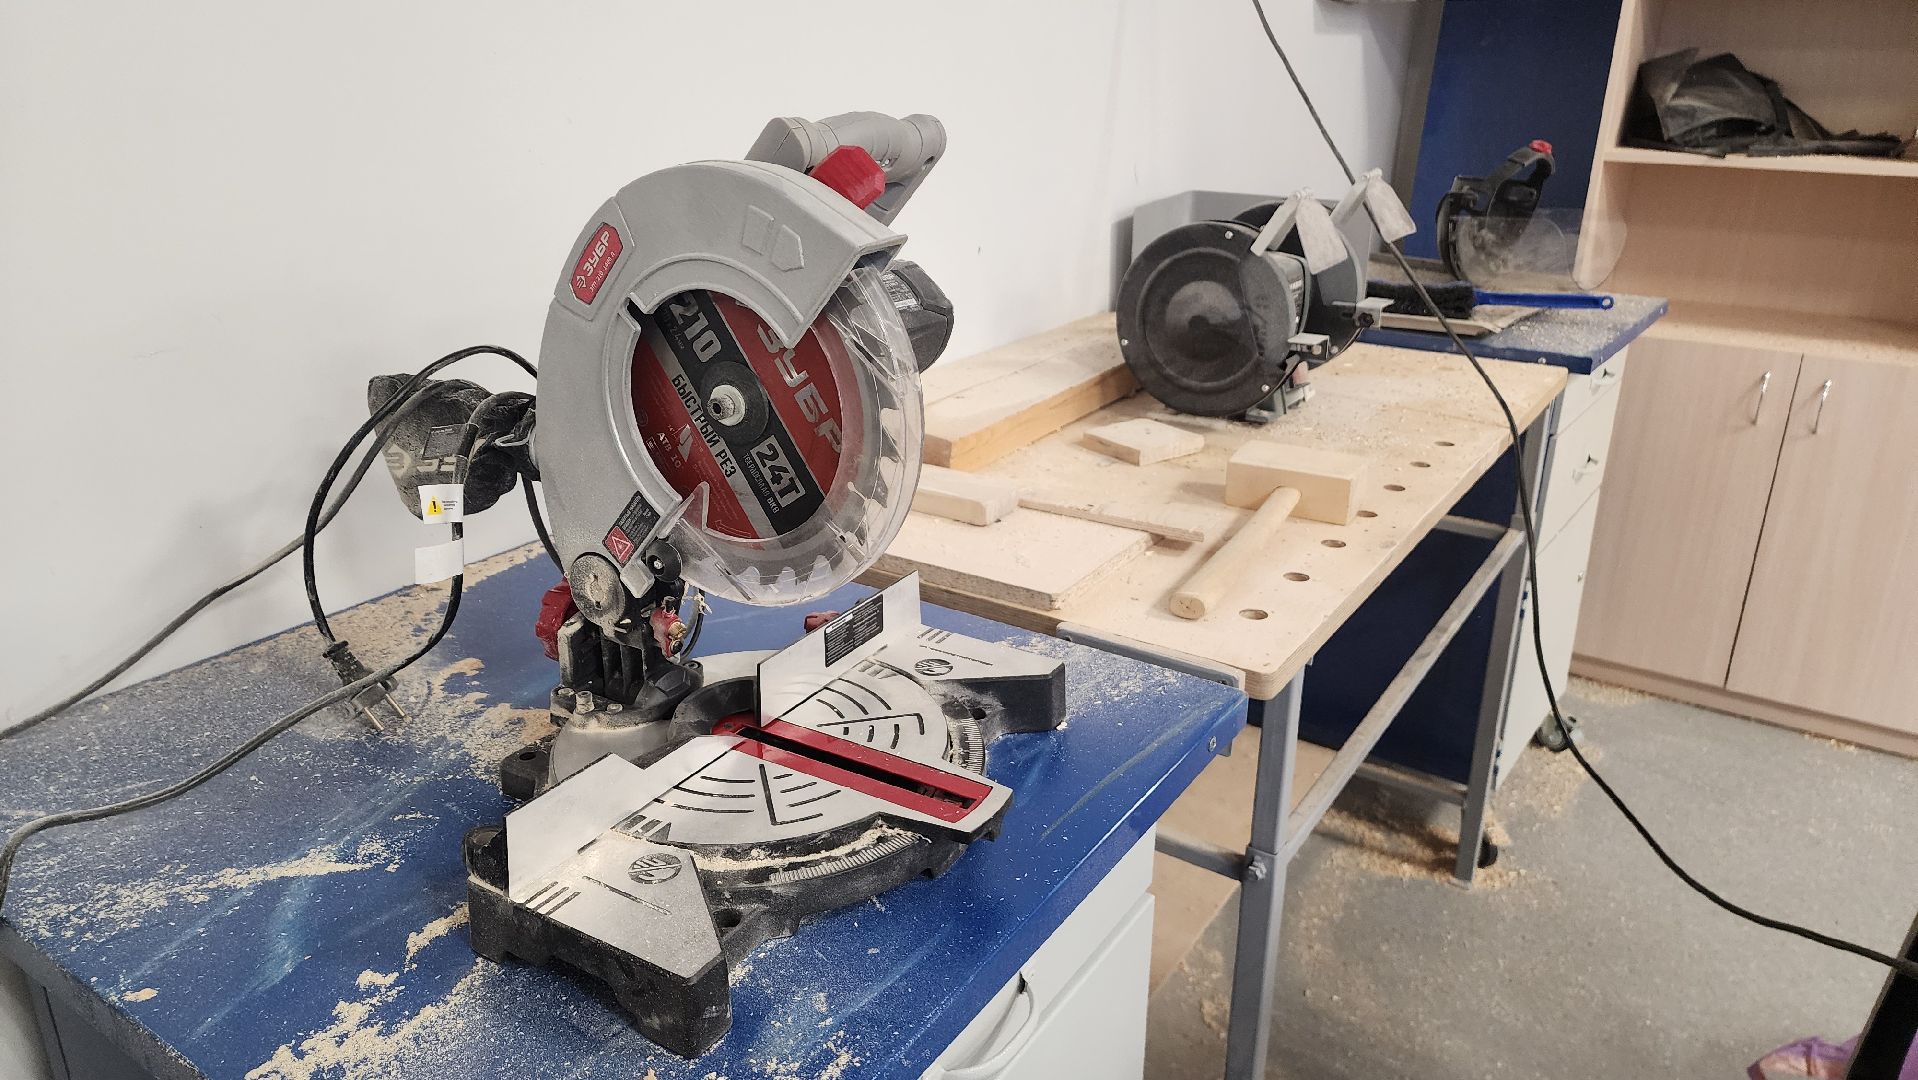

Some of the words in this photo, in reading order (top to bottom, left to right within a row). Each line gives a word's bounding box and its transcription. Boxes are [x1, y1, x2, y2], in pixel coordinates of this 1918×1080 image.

[583, 230, 610, 277] ЗУБР
[668, 292, 722, 363] 210
[672, 374, 721, 449] БЫСТРЫЙ
[715, 449, 737, 478] РЕЗ
[757, 324, 842, 454] ЗУБР
